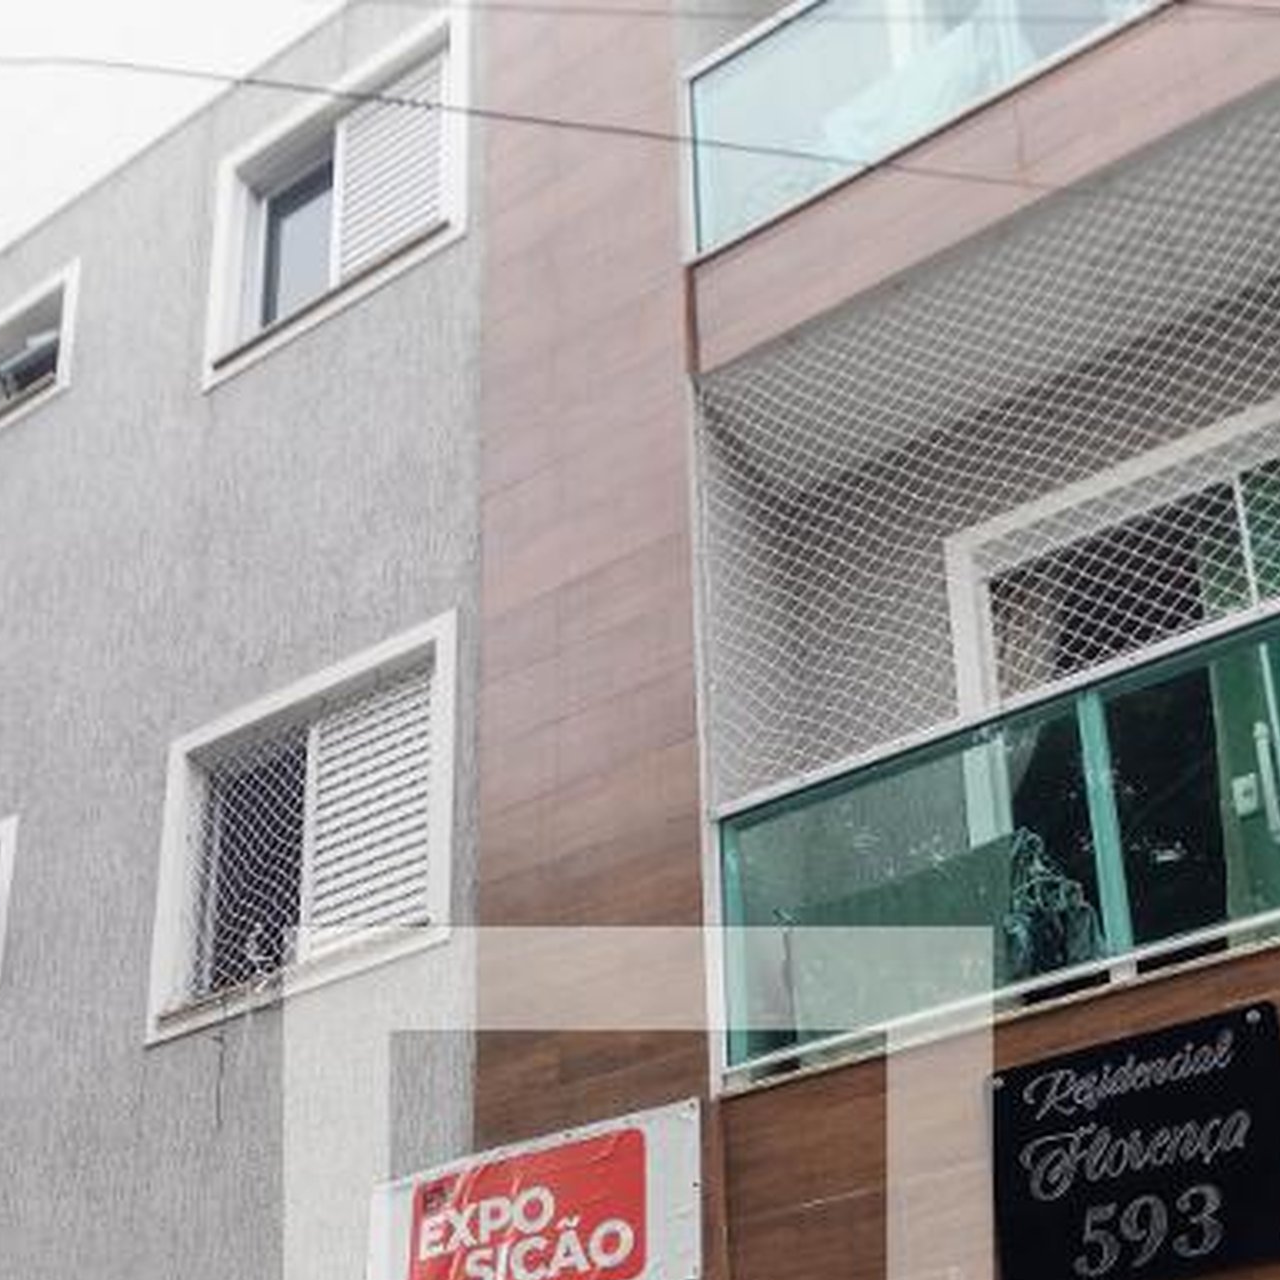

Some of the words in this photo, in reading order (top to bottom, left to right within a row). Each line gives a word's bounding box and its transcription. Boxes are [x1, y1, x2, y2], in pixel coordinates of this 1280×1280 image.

[1023, 1030, 1233, 1120] Residencial
[1020, 1110, 1252, 1200] Florença
[419, 1186, 555, 1260] EXPO
[1073, 1184, 1222, 1277] 593
